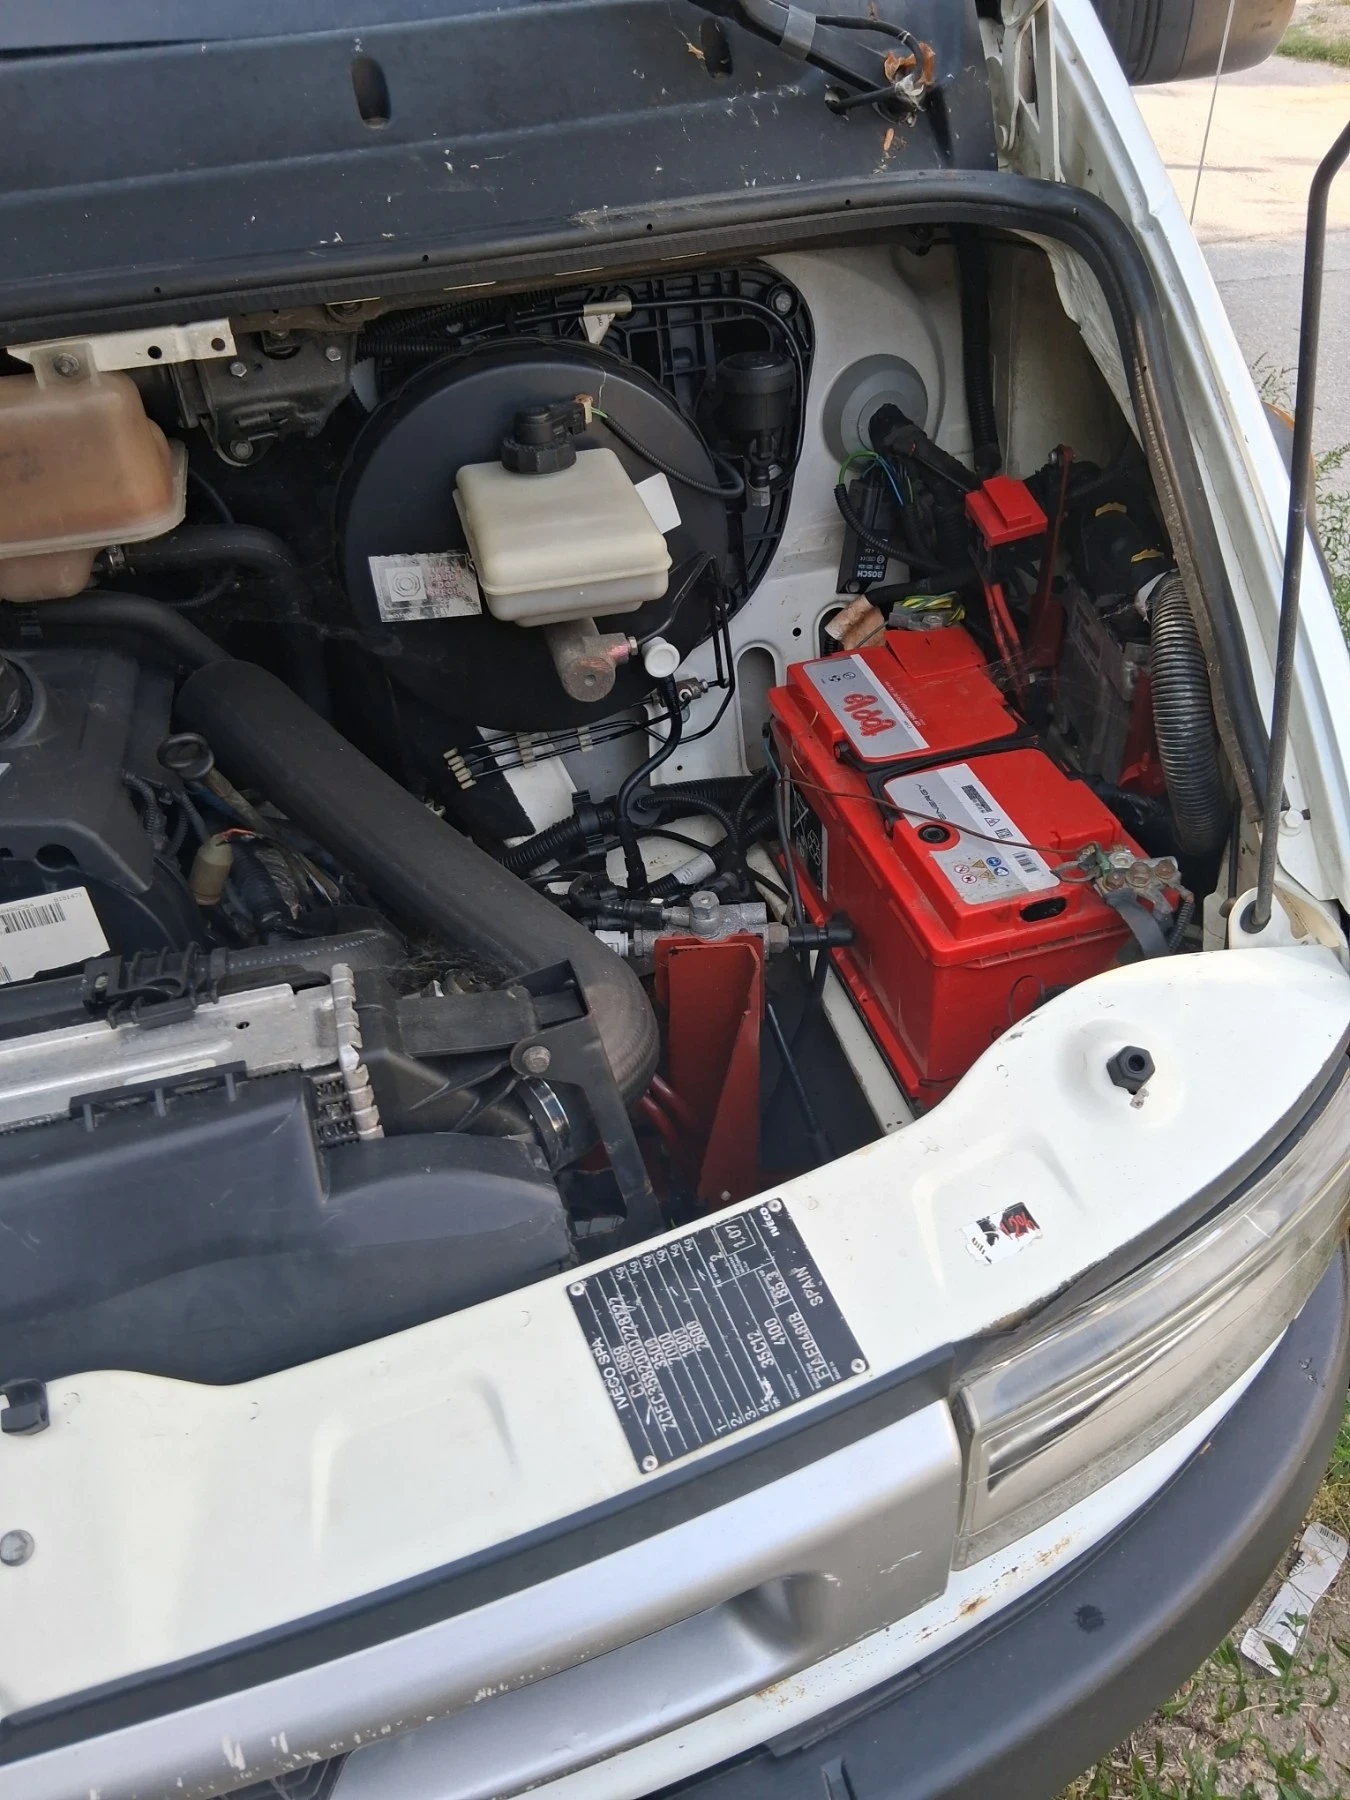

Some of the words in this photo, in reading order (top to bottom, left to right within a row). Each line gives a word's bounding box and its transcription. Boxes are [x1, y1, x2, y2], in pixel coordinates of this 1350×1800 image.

[915, 784, 947, 820] ENERGY
[758, 1206, 780, 1237] IVECO
[654, 1248, 669, 1263] Kg
[668, 1243, 681, 1257] Kg
[682, 1237, 695, 1251] Kg
[709, 1250, 723, 1262] 2
[613, 1266, 626, 1280] Kg
[627, 1260, 641, 1274] Kg
[641, 1254, 654, 1268] Kg
[792, 1264, 824, 1307] SPAIN
[672, 1326, 696, 1358] 1900
[685, 1318, 710, 1352] 2600
[763, 1316, 788, 1347] 4100
[590, 1336, 611, 1366] SPA
[643, 1336, 668, 1370] 3500
[657, 1331, 681, 1365] 7000
[746, 1328, 775, 1369] 35C12
[602, 1365, 629, 1409] IVECO
